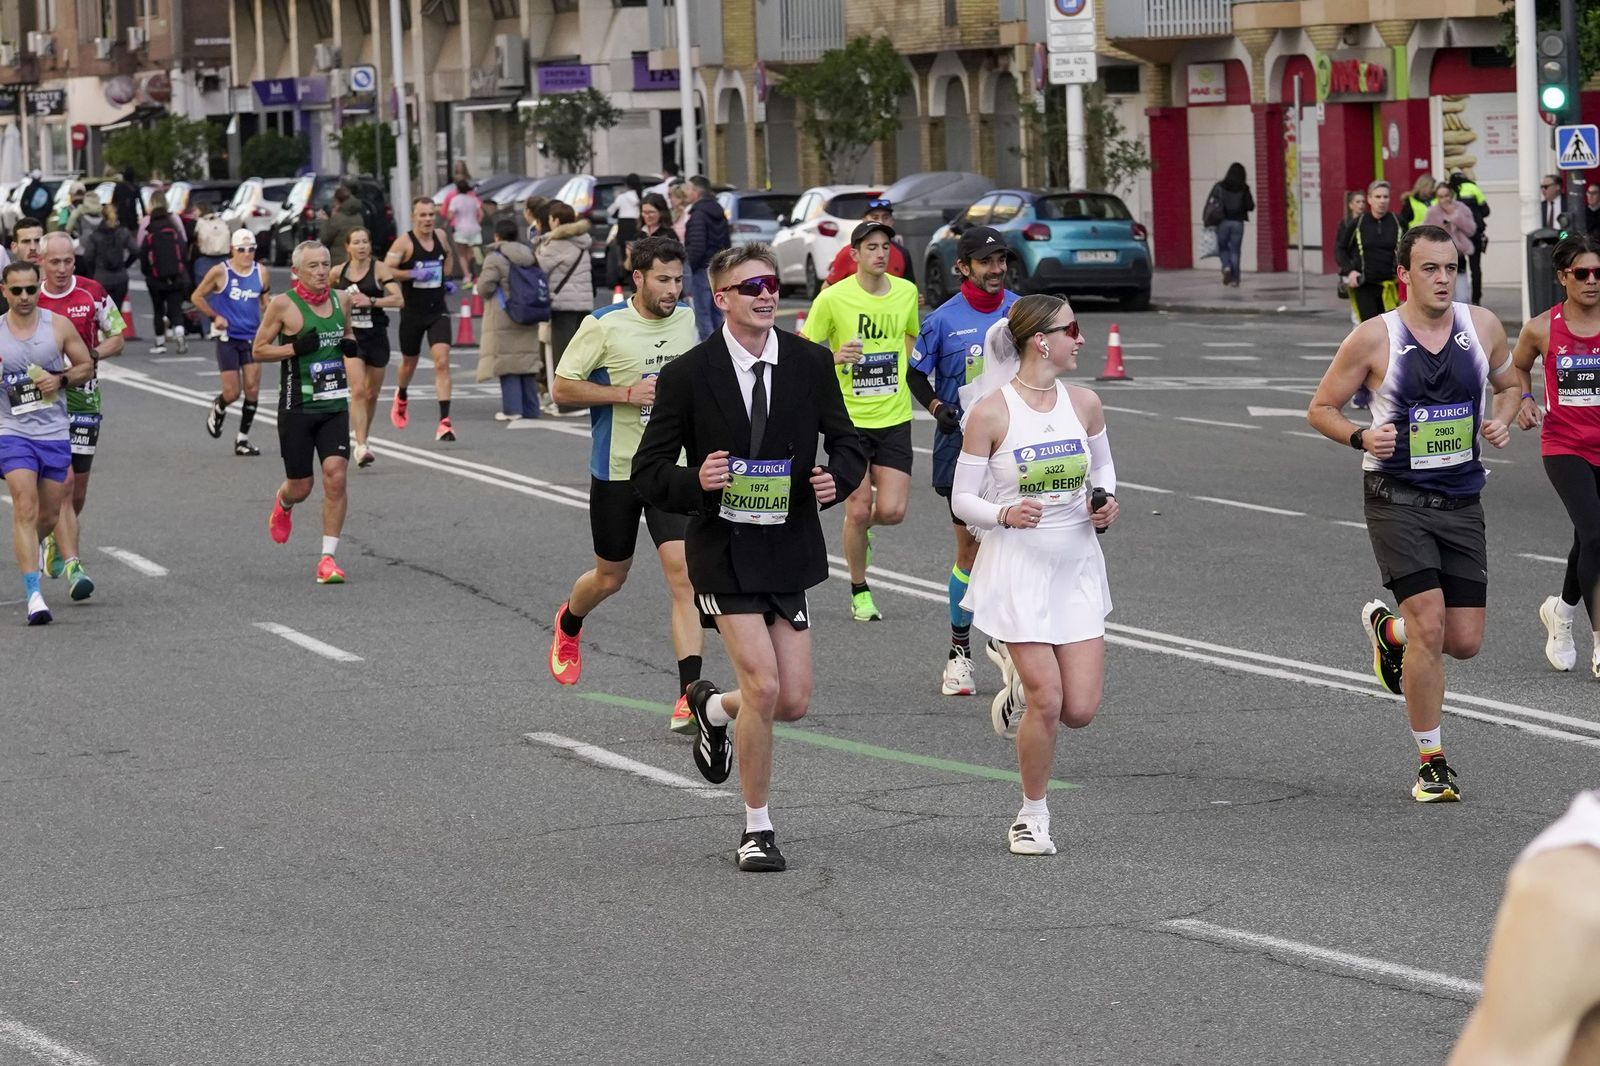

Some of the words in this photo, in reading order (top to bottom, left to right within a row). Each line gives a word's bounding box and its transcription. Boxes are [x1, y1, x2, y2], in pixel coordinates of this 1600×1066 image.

[1074, 56, 1089, 65] AZUL
[1080, 68, 1086, 76] 2
[67, 305, 90, 314] HUN
[858, 313, 899, 340] RUN
[956, 328, 978, 336] BROOKS
[852, 376, 885, 388] MANUEL
[1577, 373, 1595, 381] 3729
[324, 380, 338, 391] JEFF
[1558, 387, 1594, 396] SHAMSHUL
[1432, 406, 1469, 419] ZURICH
[1434, 426, 1455, 437] 2903
[1039, 443, 1077, 456] ZURICH
[1426, 437, 1462, 454] ENRIC
[750, 464, 785, 474] ZURICH
[1044, 463, 1065, 475] 3322
[750, 483, 769, 493] 1974
[723, 491, 788, 510] SZKUDLAR
